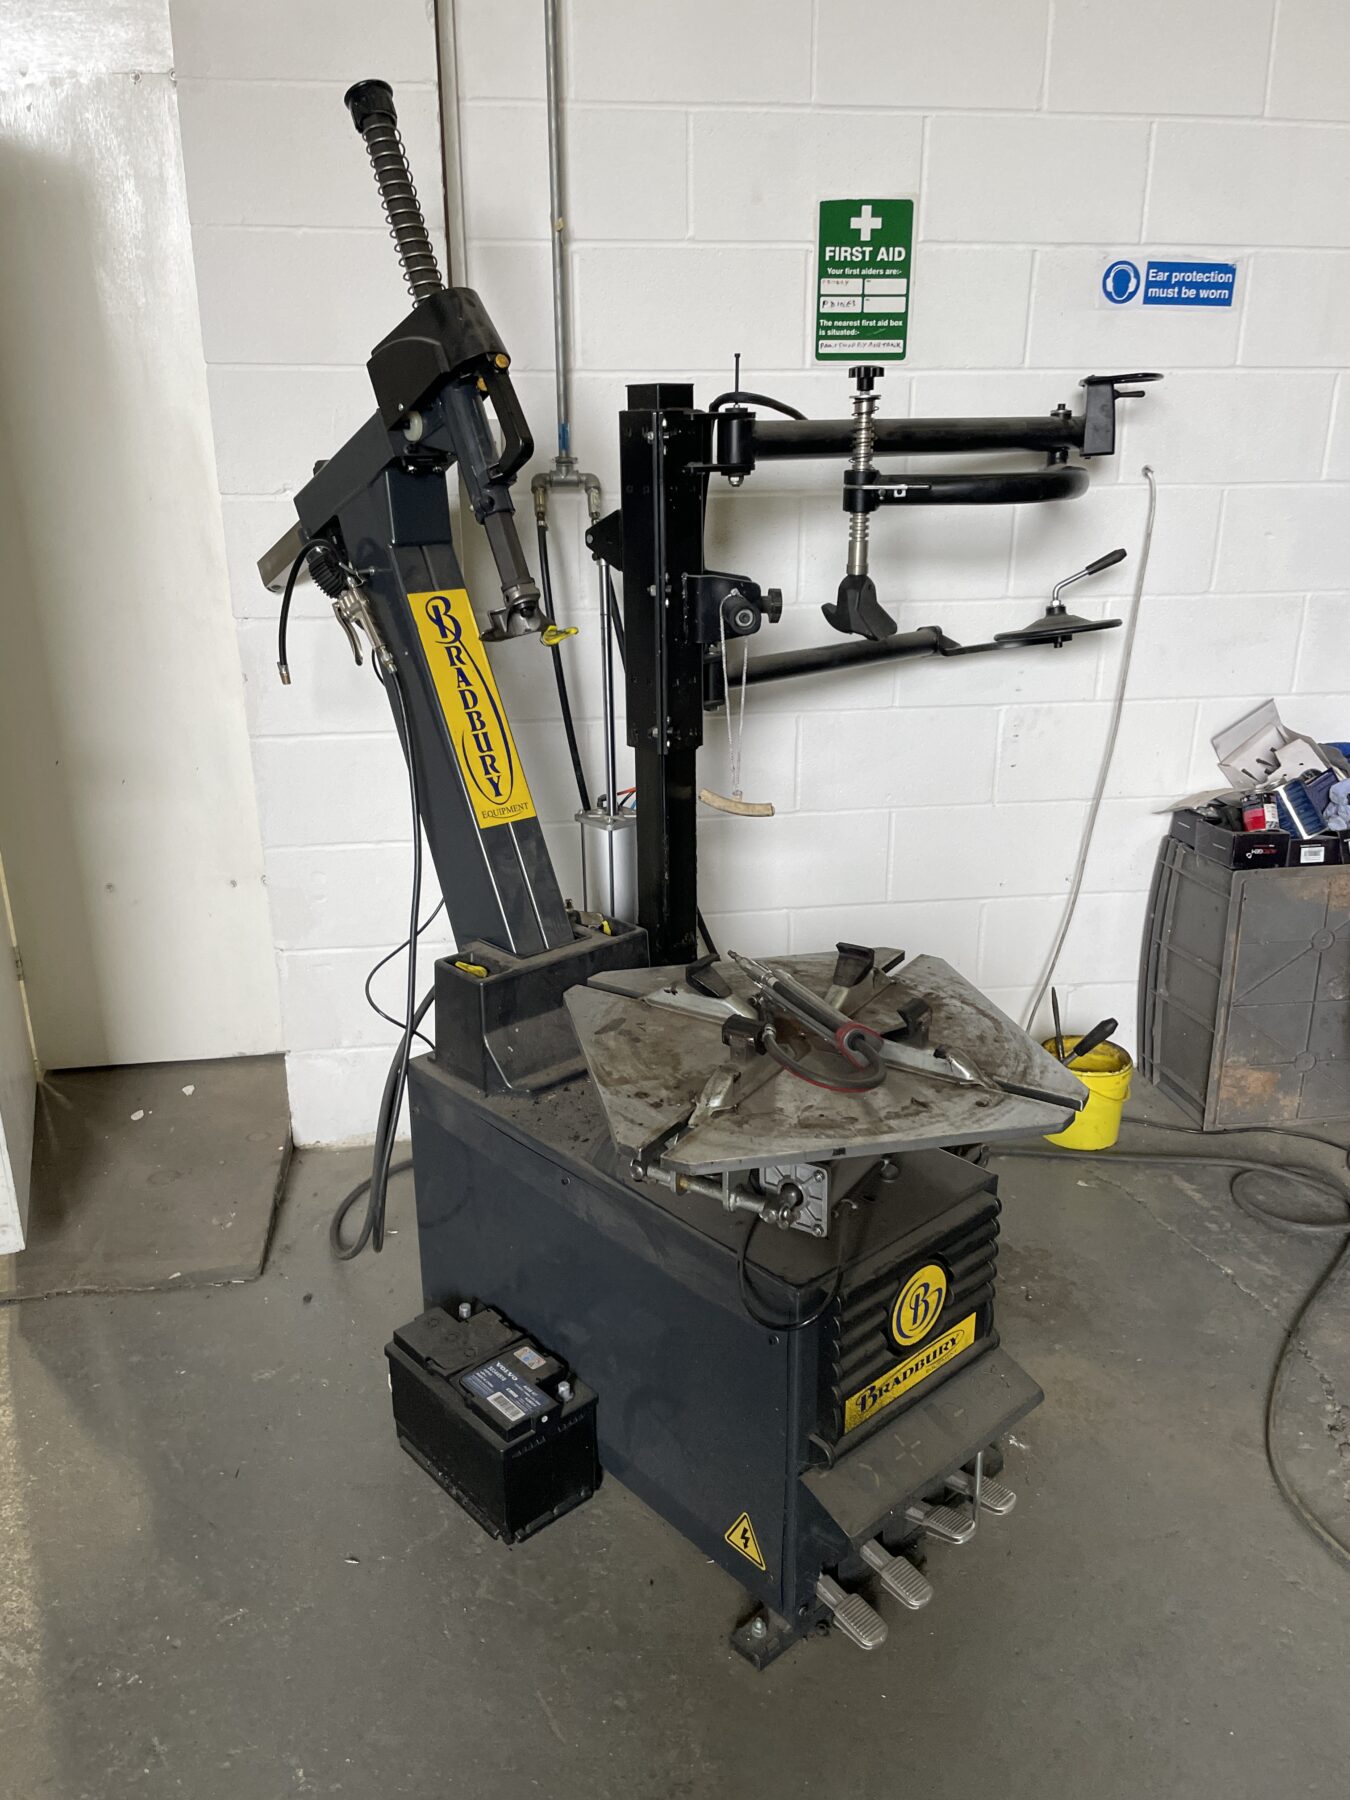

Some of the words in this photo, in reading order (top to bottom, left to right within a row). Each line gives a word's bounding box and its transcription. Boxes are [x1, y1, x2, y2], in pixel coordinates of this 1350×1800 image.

[825, 246, 873, 261] FIRST
[876, 247, 906, 261] AID
[827, 267, 843, 275] Your
[845, 267, 860, 275] first
[861, 267, 884, 275] aiders
[1148, 269, 1169, 281] Ear
[1171, 271, 1233, 284] protection
[1148, 287, 1178, 298] must
[1181, 286, 1197, 298] be
[1199, 289, 1229, 299] worn
[819, 319, 833, 327] The
[834, 319, 860, 327] nearest
[861, 319, 876, 327] first
[877, 319, 889, 327] aid
[889, 319, 903, 327] box
[819, 328, 826, 336] is
[424, 595, 503, 798] BRADBURY
[481, 802, 529, 819] EQUIPMENT
[496, 1361, 518, 1381] VOLVO
[856, 1336, 957, 1412] BRADBURY
